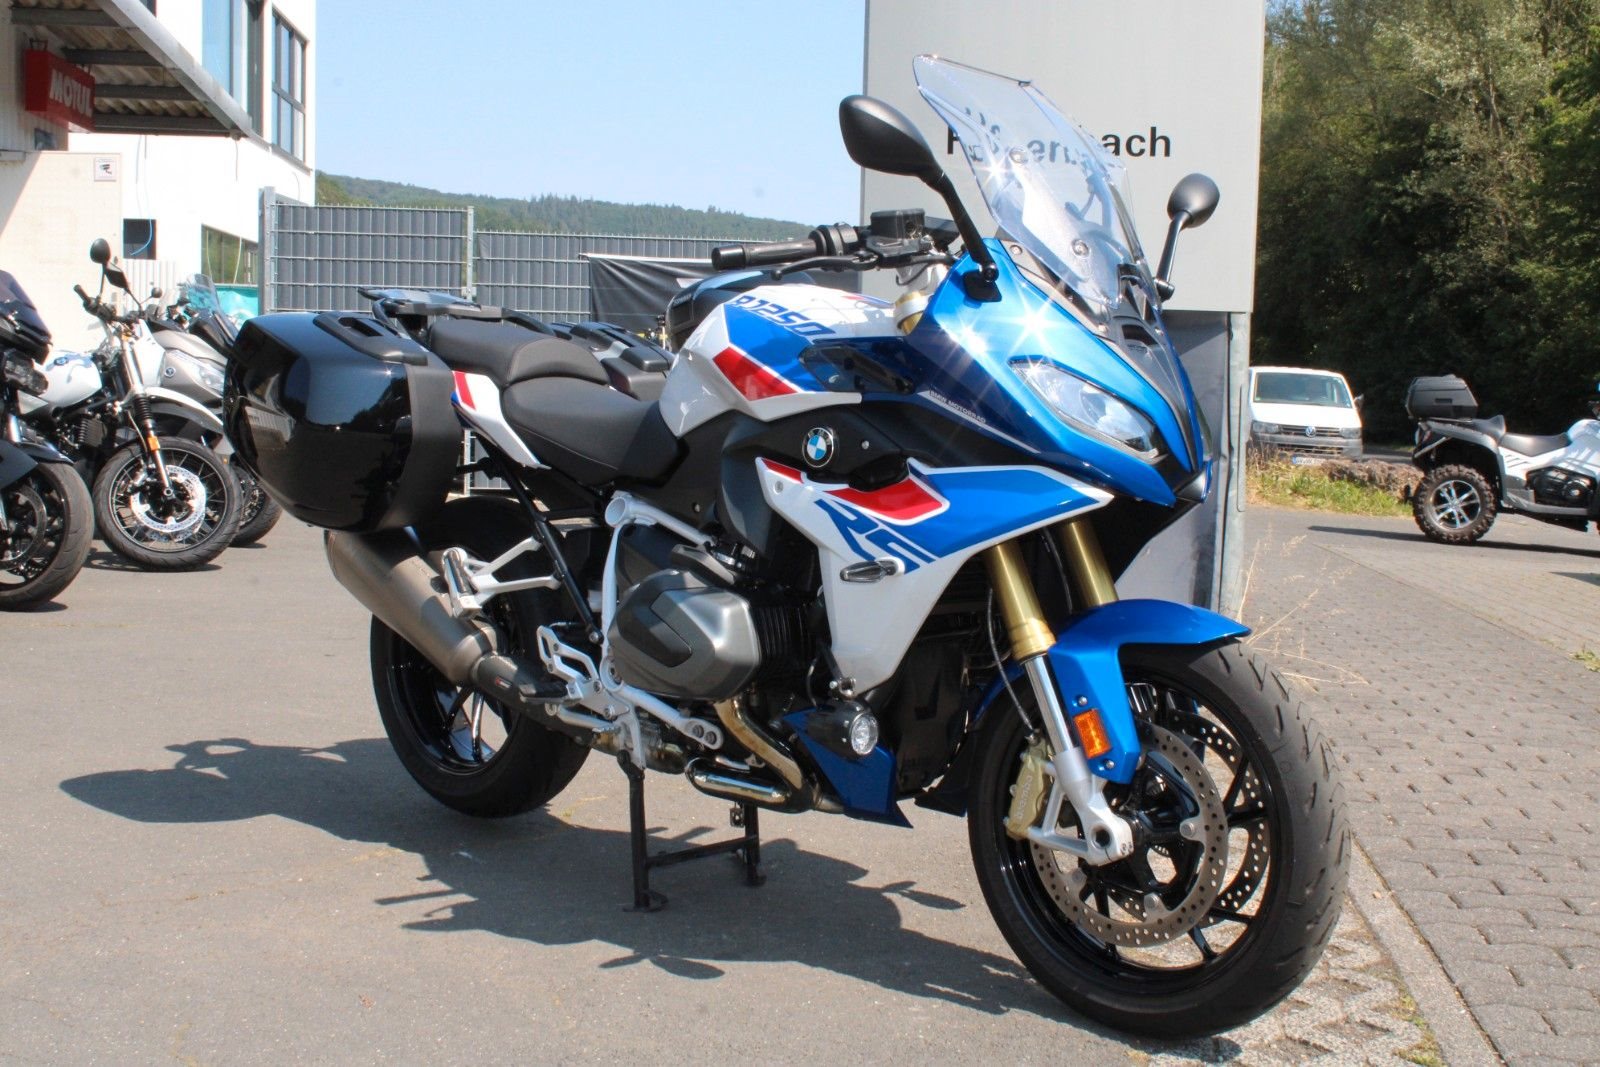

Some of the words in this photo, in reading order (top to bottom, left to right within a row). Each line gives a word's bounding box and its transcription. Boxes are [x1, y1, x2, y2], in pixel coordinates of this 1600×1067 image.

[49, 68, 93, 118] MOTUL
[947, 400, 986, 423] MOTORRAD
[814, 498, 936, 575] RS
